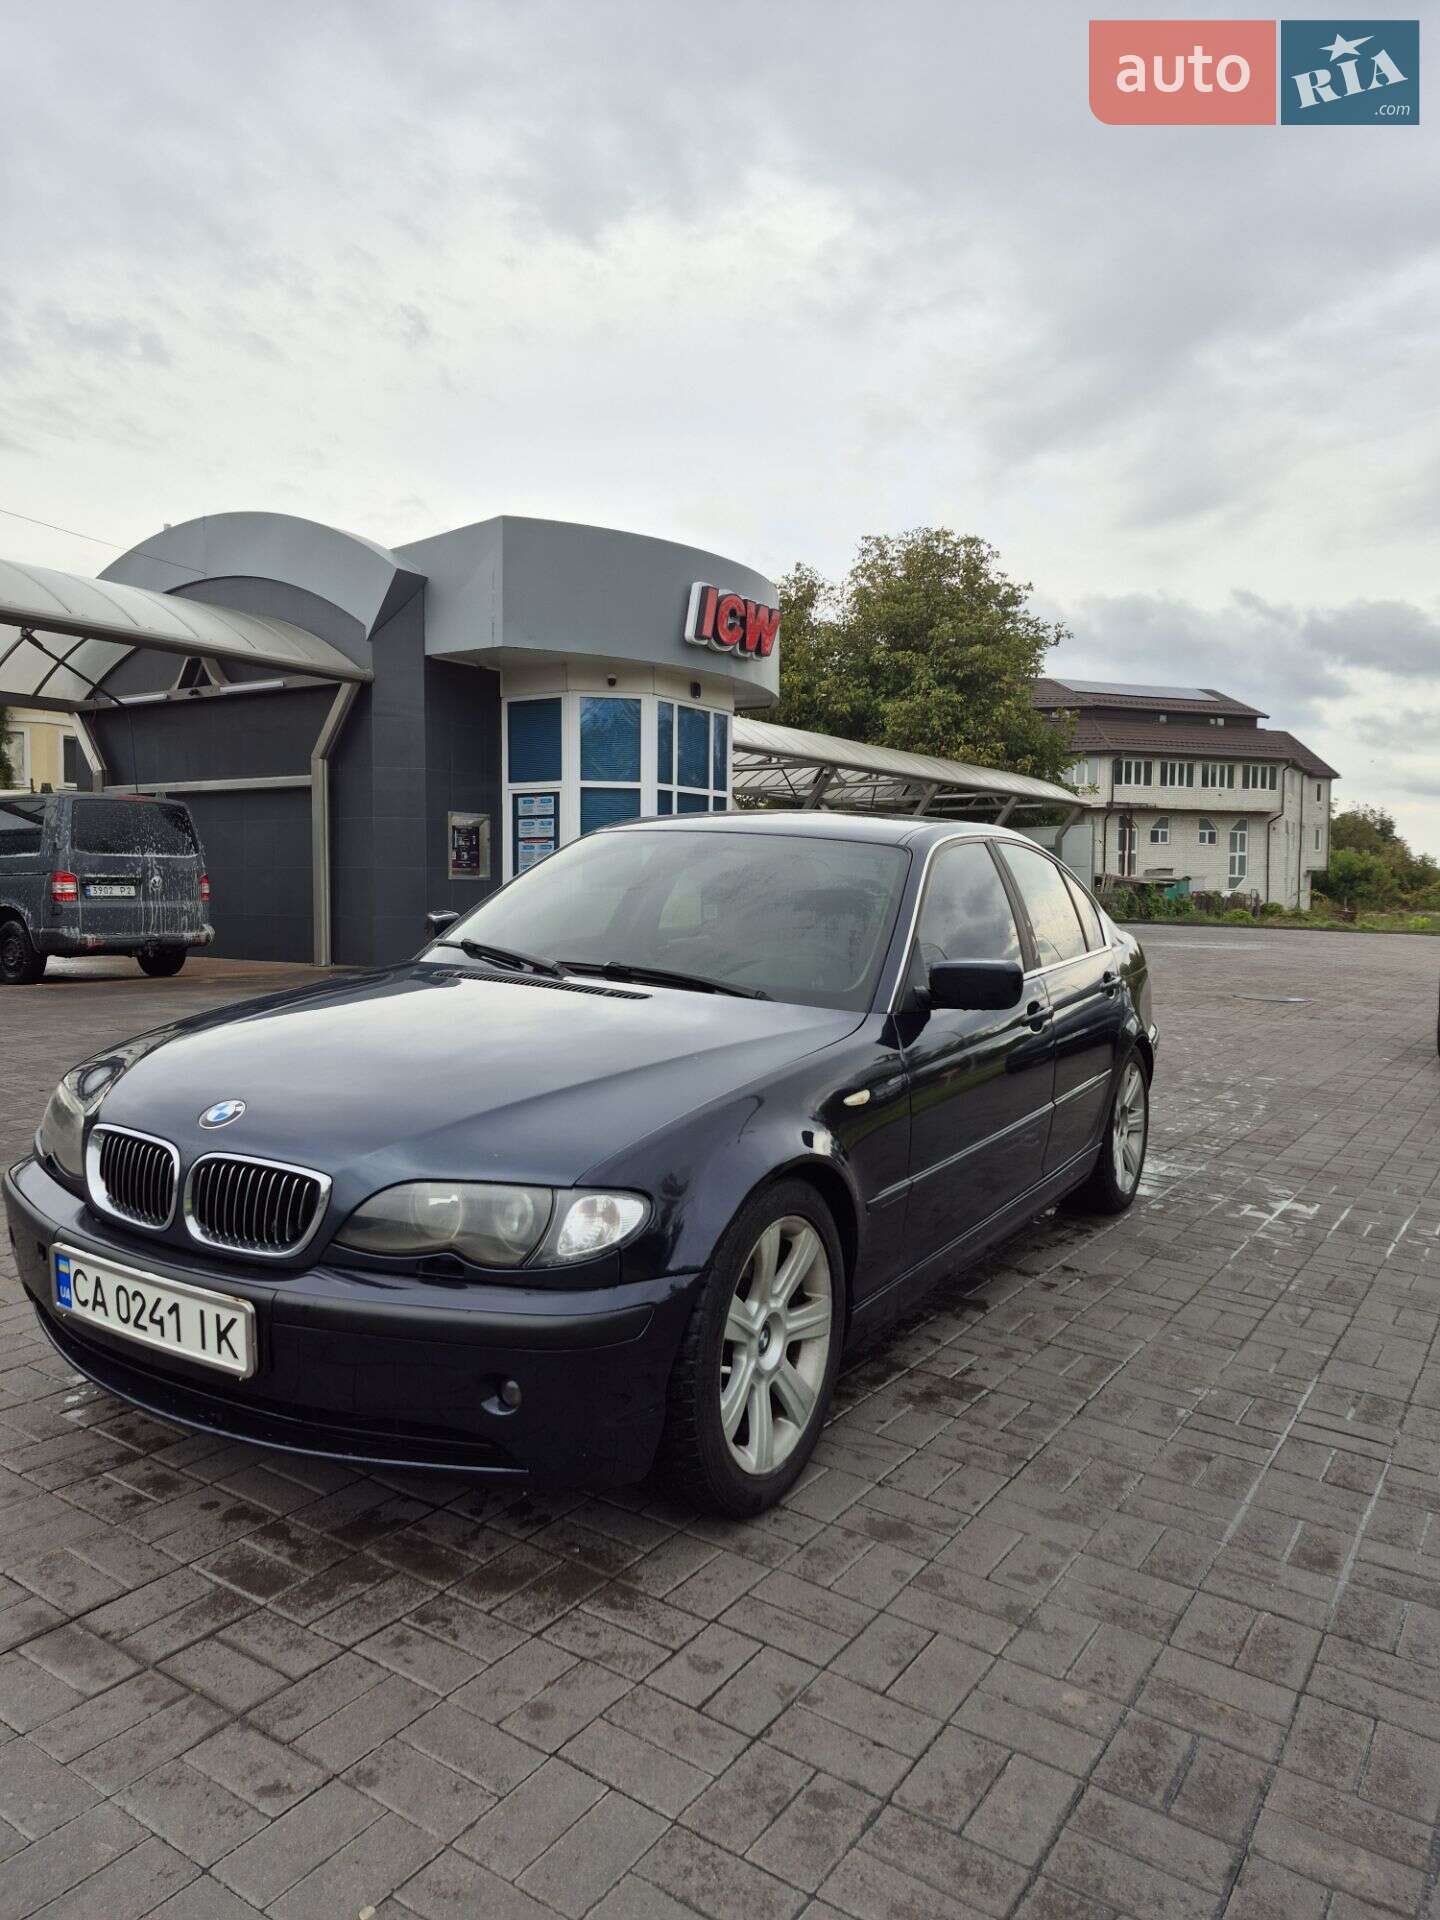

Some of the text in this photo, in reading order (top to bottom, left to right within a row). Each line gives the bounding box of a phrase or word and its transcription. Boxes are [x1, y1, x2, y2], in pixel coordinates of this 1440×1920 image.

[692, 584, 781, 658] ICW
[59, 1285, 71, 1301] UA
[72, 1268, 240, 1360] CA 0241 IK
